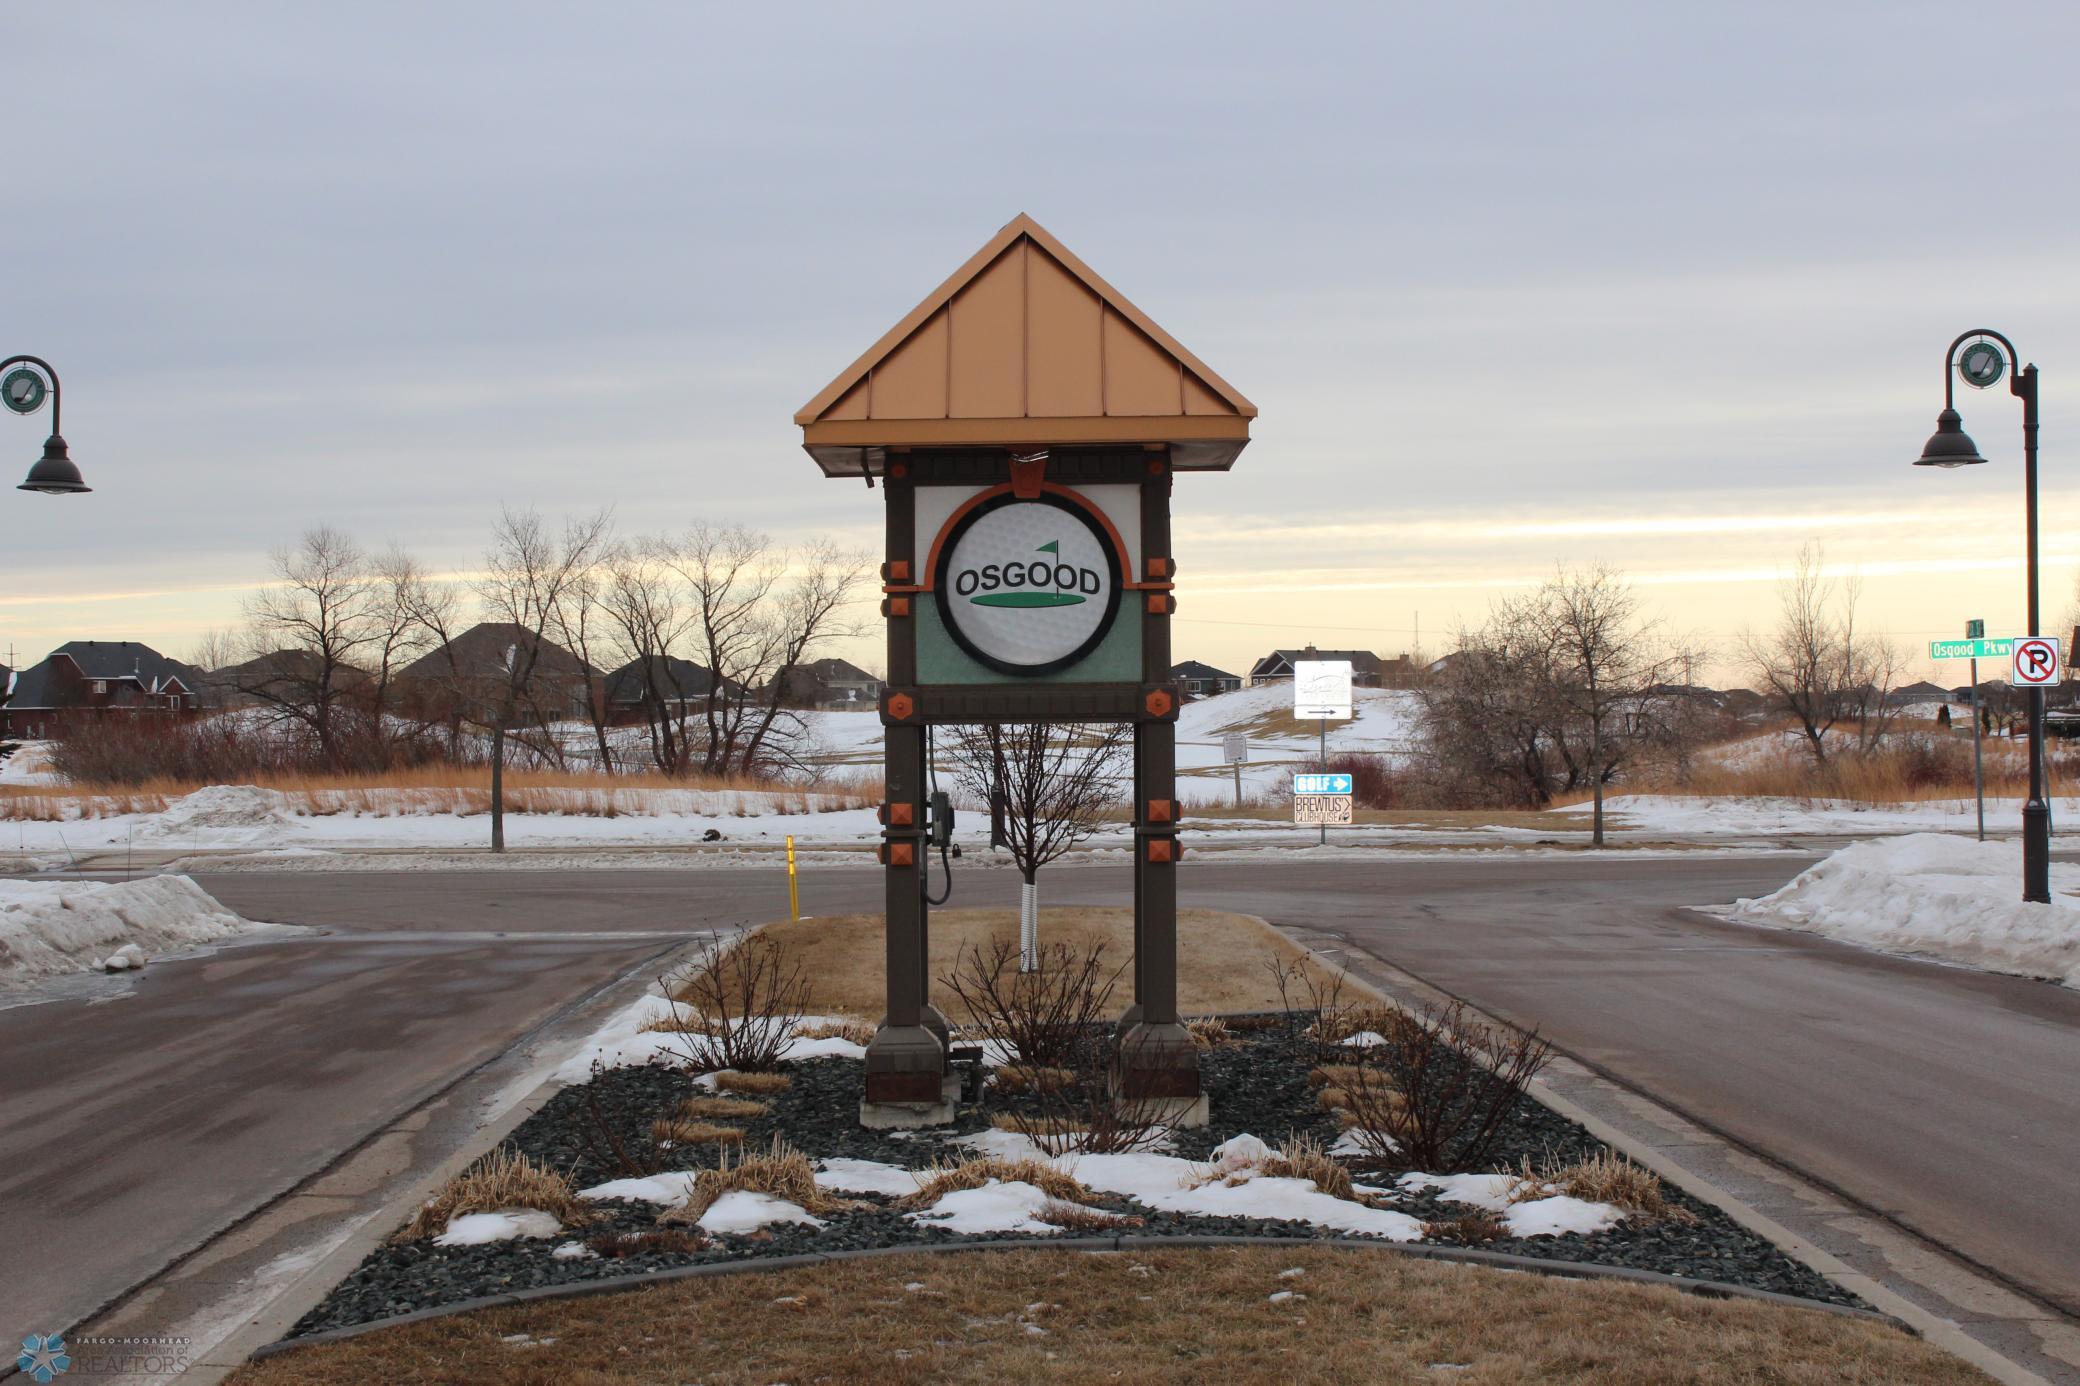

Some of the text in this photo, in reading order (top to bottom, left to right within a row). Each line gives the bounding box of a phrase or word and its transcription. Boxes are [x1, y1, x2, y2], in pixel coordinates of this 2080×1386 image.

[956, 562, 1100, 596] OSGOOD
[1933, 641, 2012, 658] Osgood Pkwy
[1297, 776, 1330, 791] GOLF
[1296, 811, 1338, 822] CLUBHOUSE
